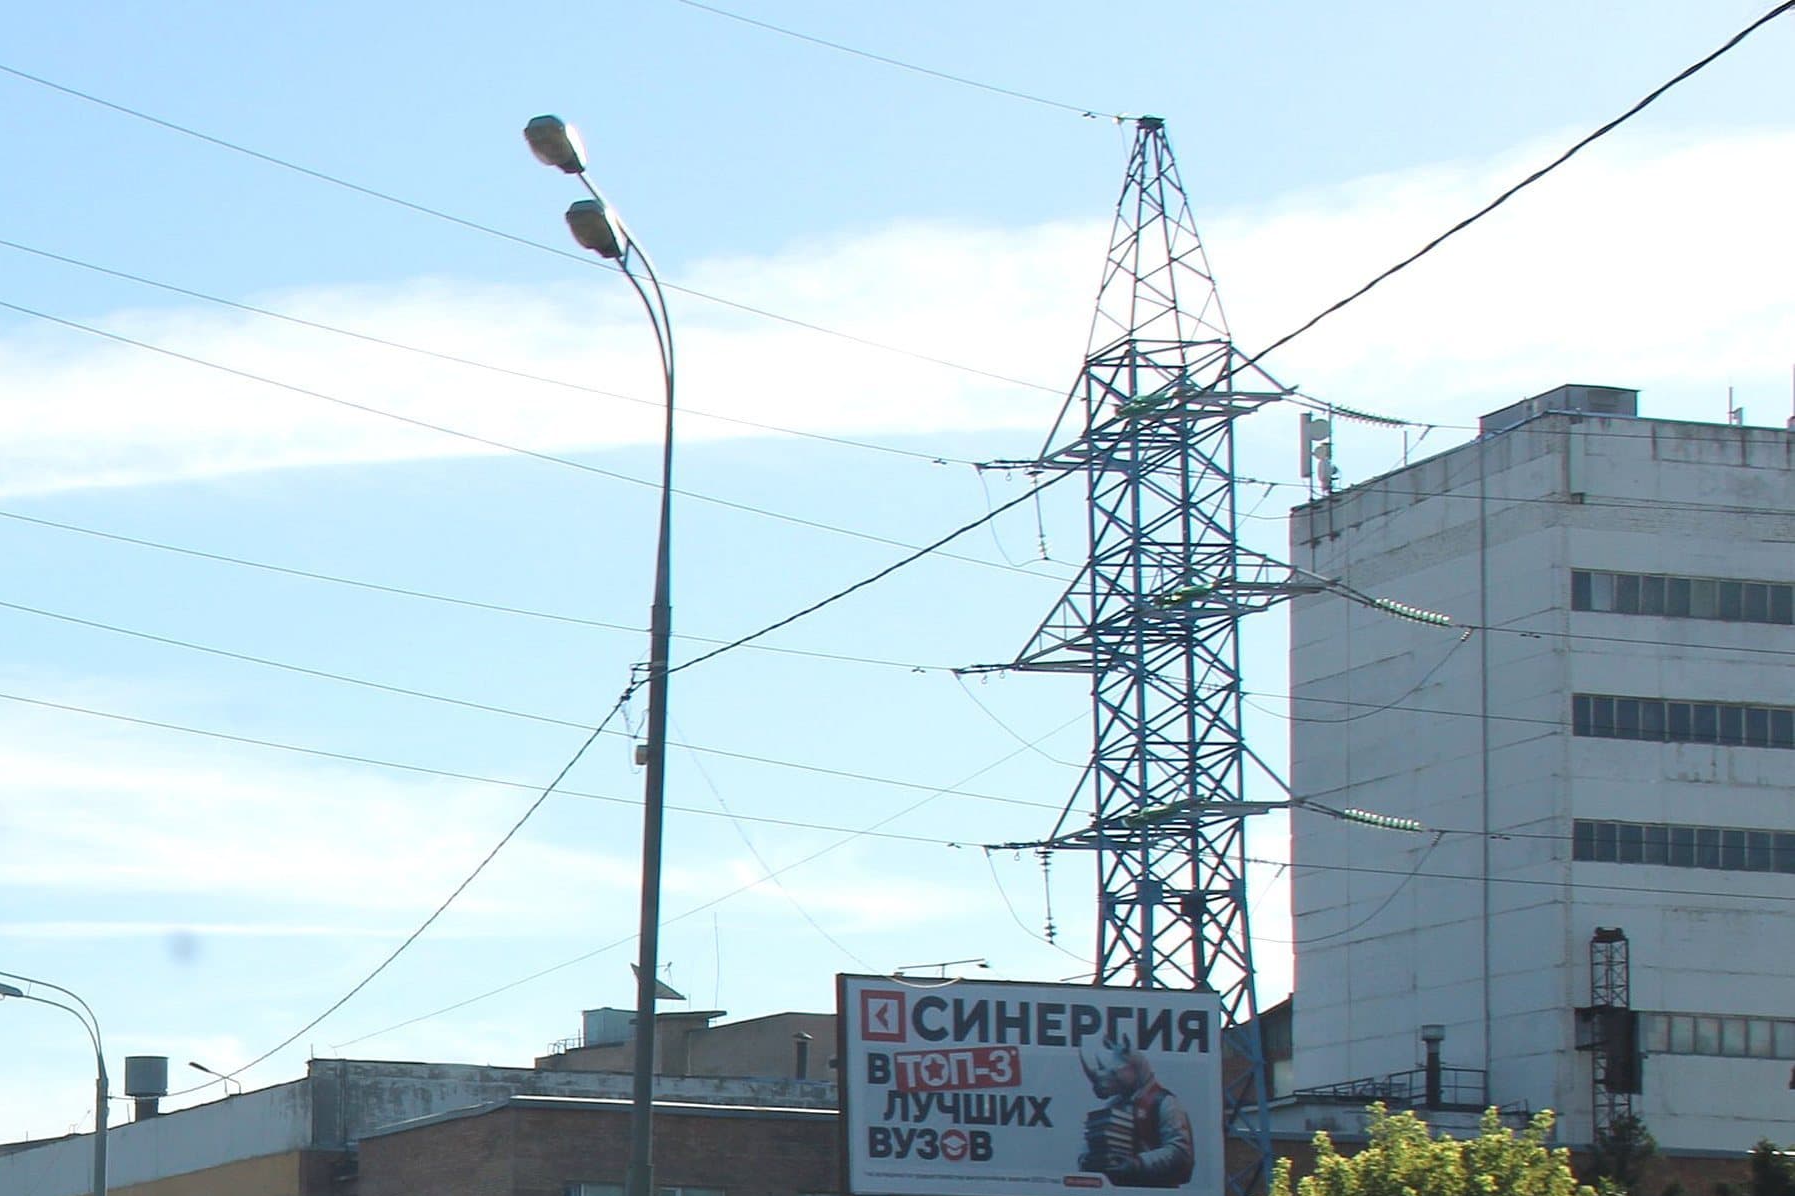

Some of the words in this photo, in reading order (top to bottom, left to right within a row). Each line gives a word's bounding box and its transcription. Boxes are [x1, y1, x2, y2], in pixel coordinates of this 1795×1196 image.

[911, 995, 1209, 1053] СИНЕРГИЯ
[867, 1052, 892, 1084] В
[883, 1089, 1054, 1128] ЛУЧШИХ
[868, 1126, 994, 1162] ВУЗОВ
